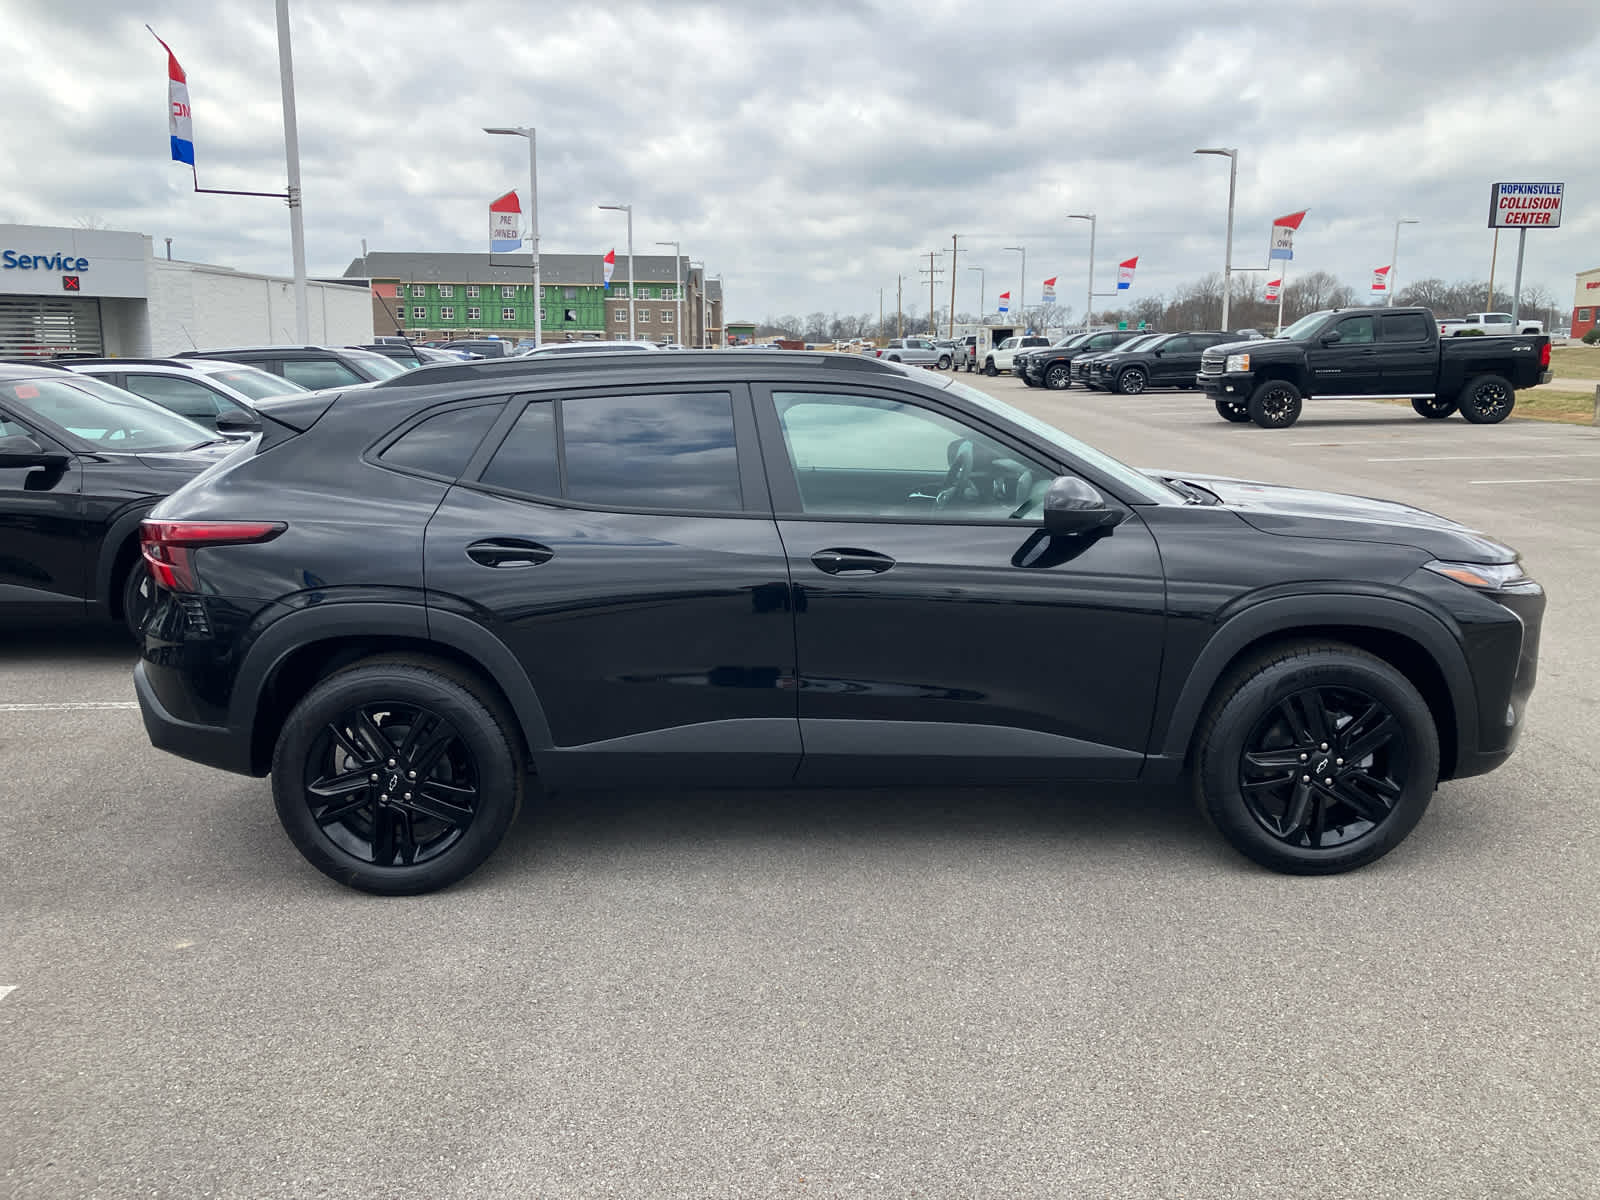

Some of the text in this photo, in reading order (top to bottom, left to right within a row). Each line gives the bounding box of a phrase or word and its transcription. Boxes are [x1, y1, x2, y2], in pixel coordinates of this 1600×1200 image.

[1500, 184, 1562, 195] HOPKINSVILLE
[1499, 196, 1561, 209] COLLISION
[1505, 212, 1551, 224] CENTER
[2, 249, 89, 272] Service
